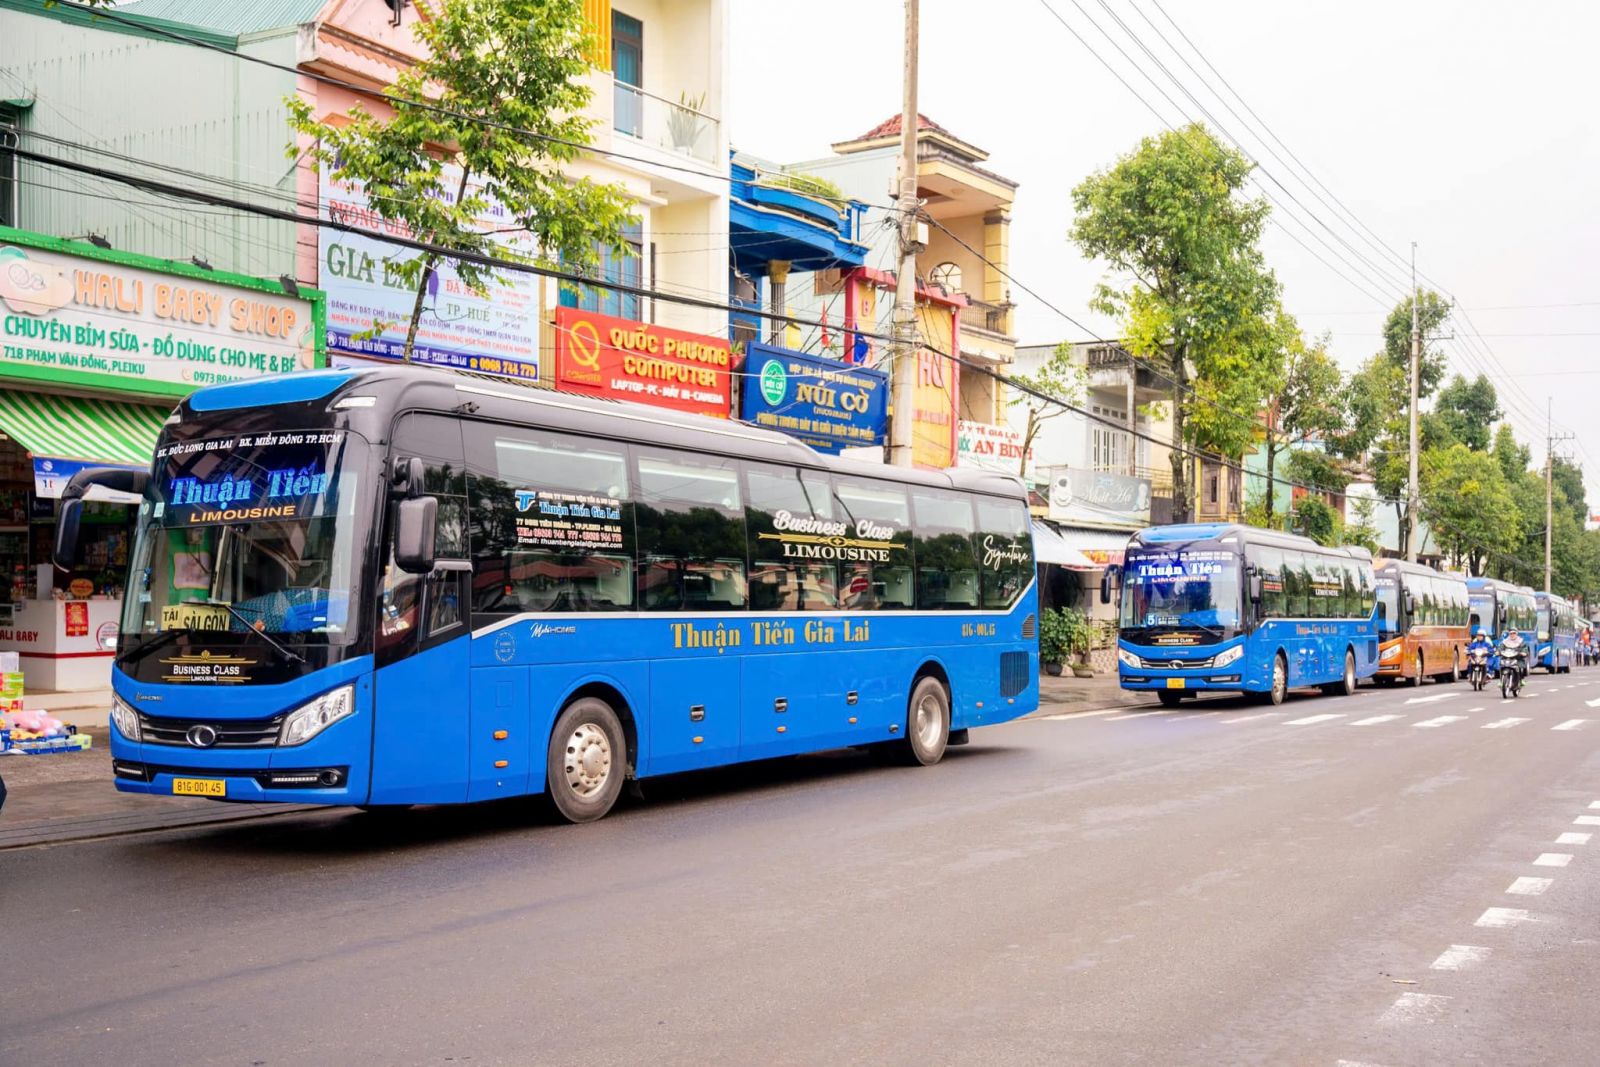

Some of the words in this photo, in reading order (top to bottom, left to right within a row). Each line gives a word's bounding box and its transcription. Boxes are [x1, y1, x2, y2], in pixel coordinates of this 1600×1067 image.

[327, 243, 375, 283] GIA
[76, 268, 144, 314] HALI
[155, 283, 223, 327] BABY
[230, 297, 297, 338] SHOP
[4, 315, 71, 343] CHUYÊN
[220, 347, 246, 368] CHO
[249, 351, 267, 373] MẸ
[269, 355, 279, 372] &
[609, 323, 658, 353] QUỐC
[3, 345, 23, 360] 718
[26, 348, 56, 365] PHẠM
[112, 360, 145, 375] PLEIKU
[623, 355, 717, 388] COMPUTER
[193, 371, 215, 384] 0973
[796, 380, 837, 408] NÚI
[184, 444, 204, 455] LONG
[205, 441, 218, 451] GIA
[219, 439, 233, 450] LAI
[238, 437, 253, 448] BX.
[278, 434, 303, 446] ĐÔNG
[974, 439, 995, 455] AN
[170, 472, 252, 510] Thuận
[267, 460, 328, 498] Tiến
[190, 505, 296, 523] LIMOUSINE
[773, 510, 847, 537] Business
[855, 519, 894, 541] Class
[783, 543, 890, 563] LIMOUSINE
[983, 535, 1030, 572] Signature
[1138, 564, 1183, 578] Thuận
[1189, 561, 1222, 574] Tiến
[1151, 575, 1208, 584] LIMOUSINE
[183, 610, 201, 631] SÀI
[204, 610, 227, 631] GÒN
[16, 630, 39, 643] BABY
[670, 620, 741, 655] Thuận
[750, 620, 794, 646] Tiến
[804, 620, 834, 644] Gia
[843, 620, 870, 643] Lai
[177, 781, 221, 793] 81G-001.45
